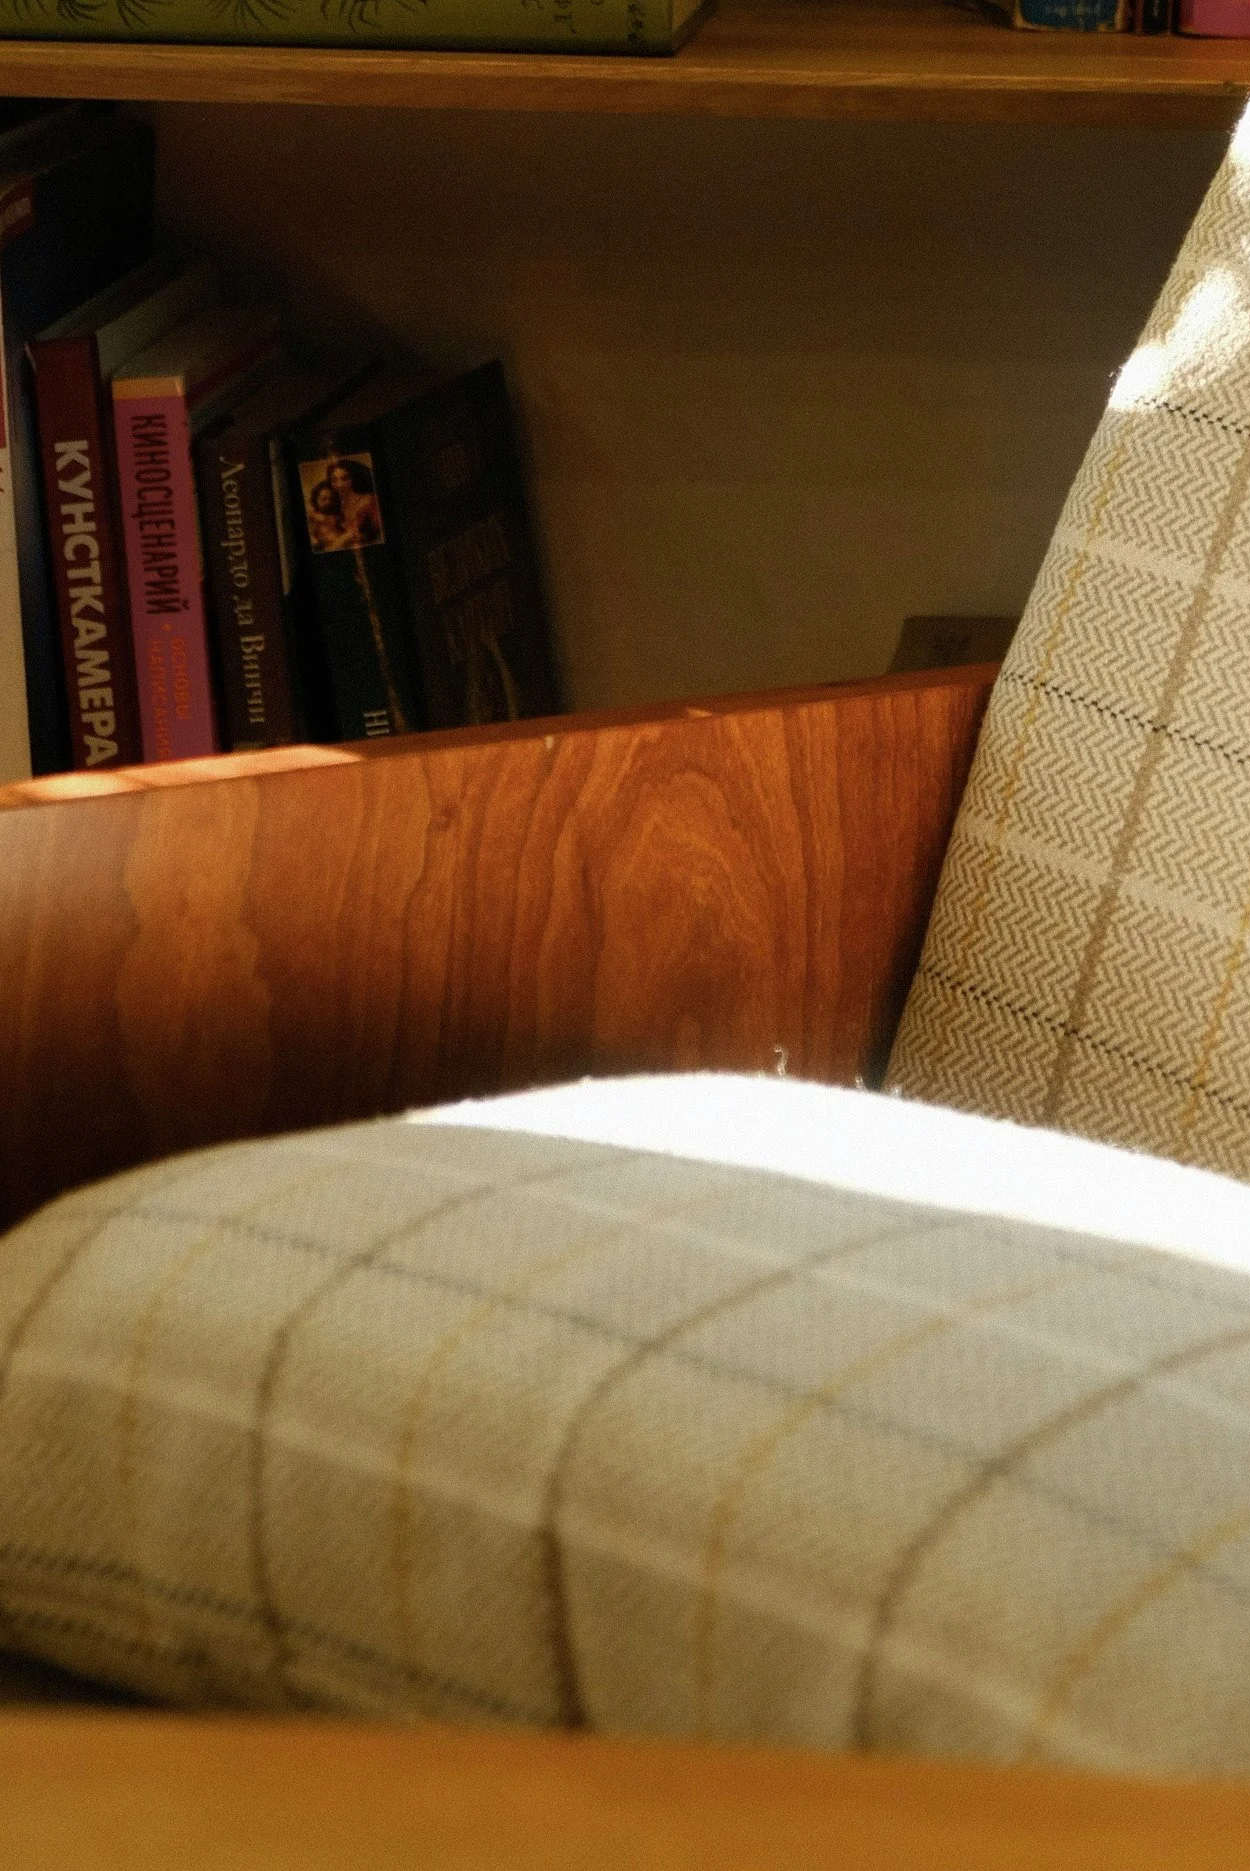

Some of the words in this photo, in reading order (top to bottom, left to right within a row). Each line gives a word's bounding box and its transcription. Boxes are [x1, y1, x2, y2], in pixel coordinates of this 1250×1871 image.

[130, 413, 190, 616] КИНОСЦЕНАРИЙ
[218, 456, 252, 589] Леонардо
[53, 439, 119, 768] КУНСТКАМЕРА
[231, 594, 255, 627] да
[239, 634, 266, 725] Винчи
